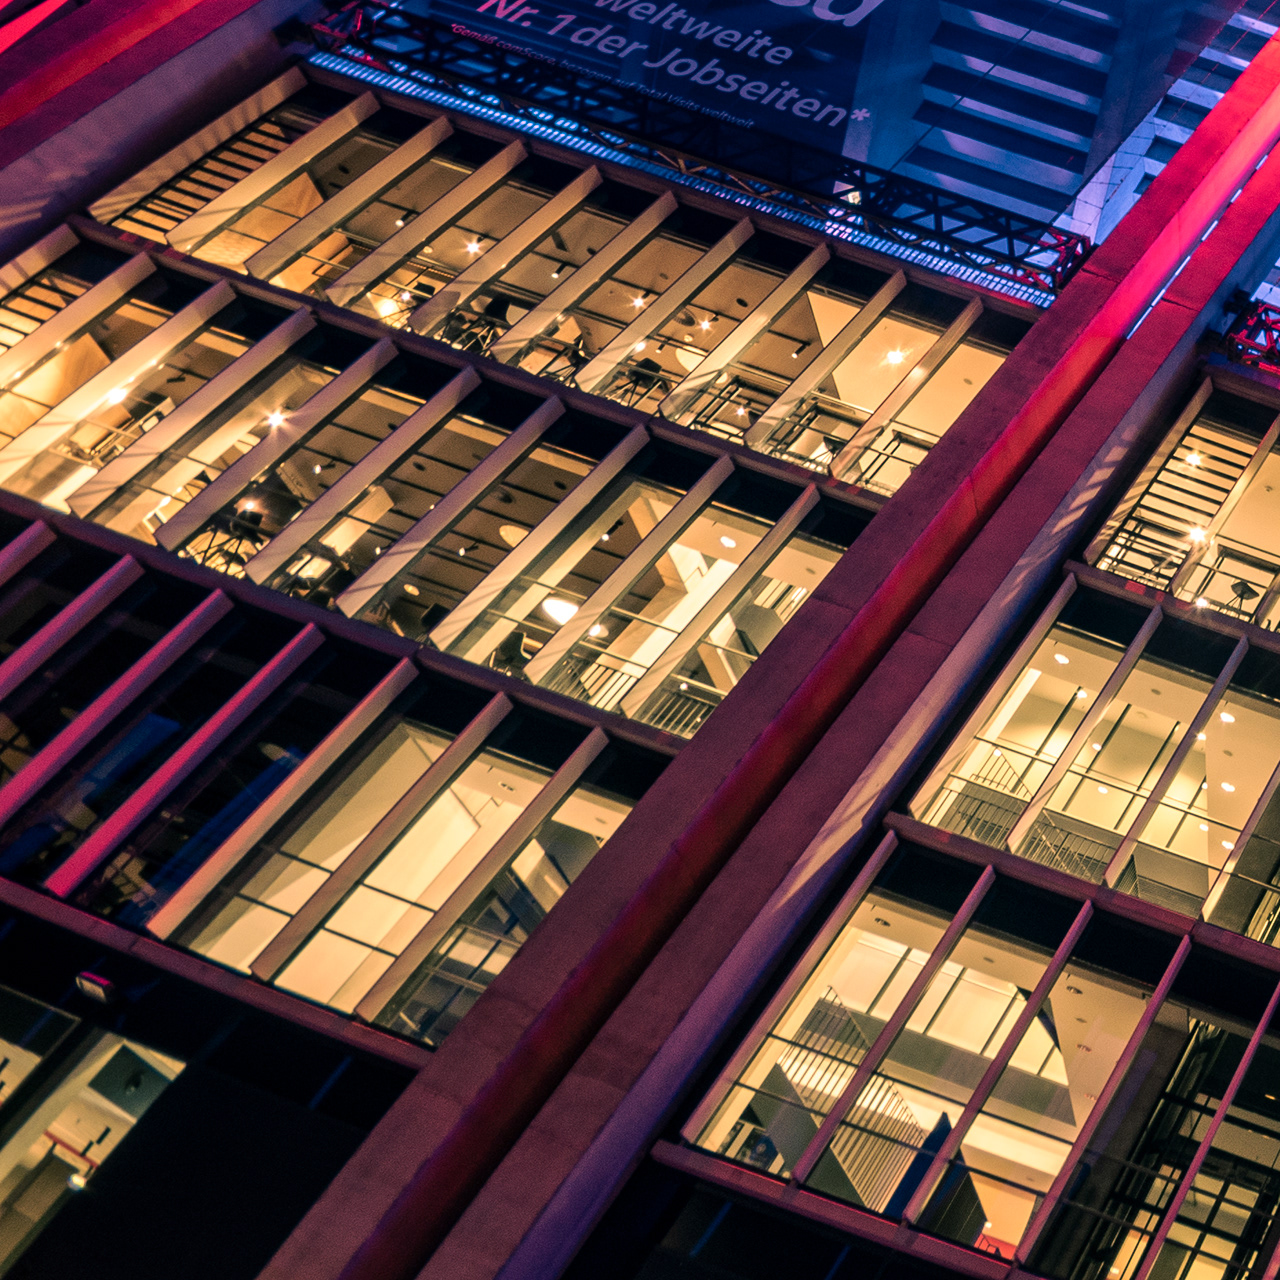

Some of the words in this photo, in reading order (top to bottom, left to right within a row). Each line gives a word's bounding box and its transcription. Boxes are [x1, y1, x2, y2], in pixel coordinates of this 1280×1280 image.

[546, 14, 577, 35] 1
[570, 13, 648, 59] der
[636, 83, 667, 99] Total
[666, 93, 700, 111] Visits
